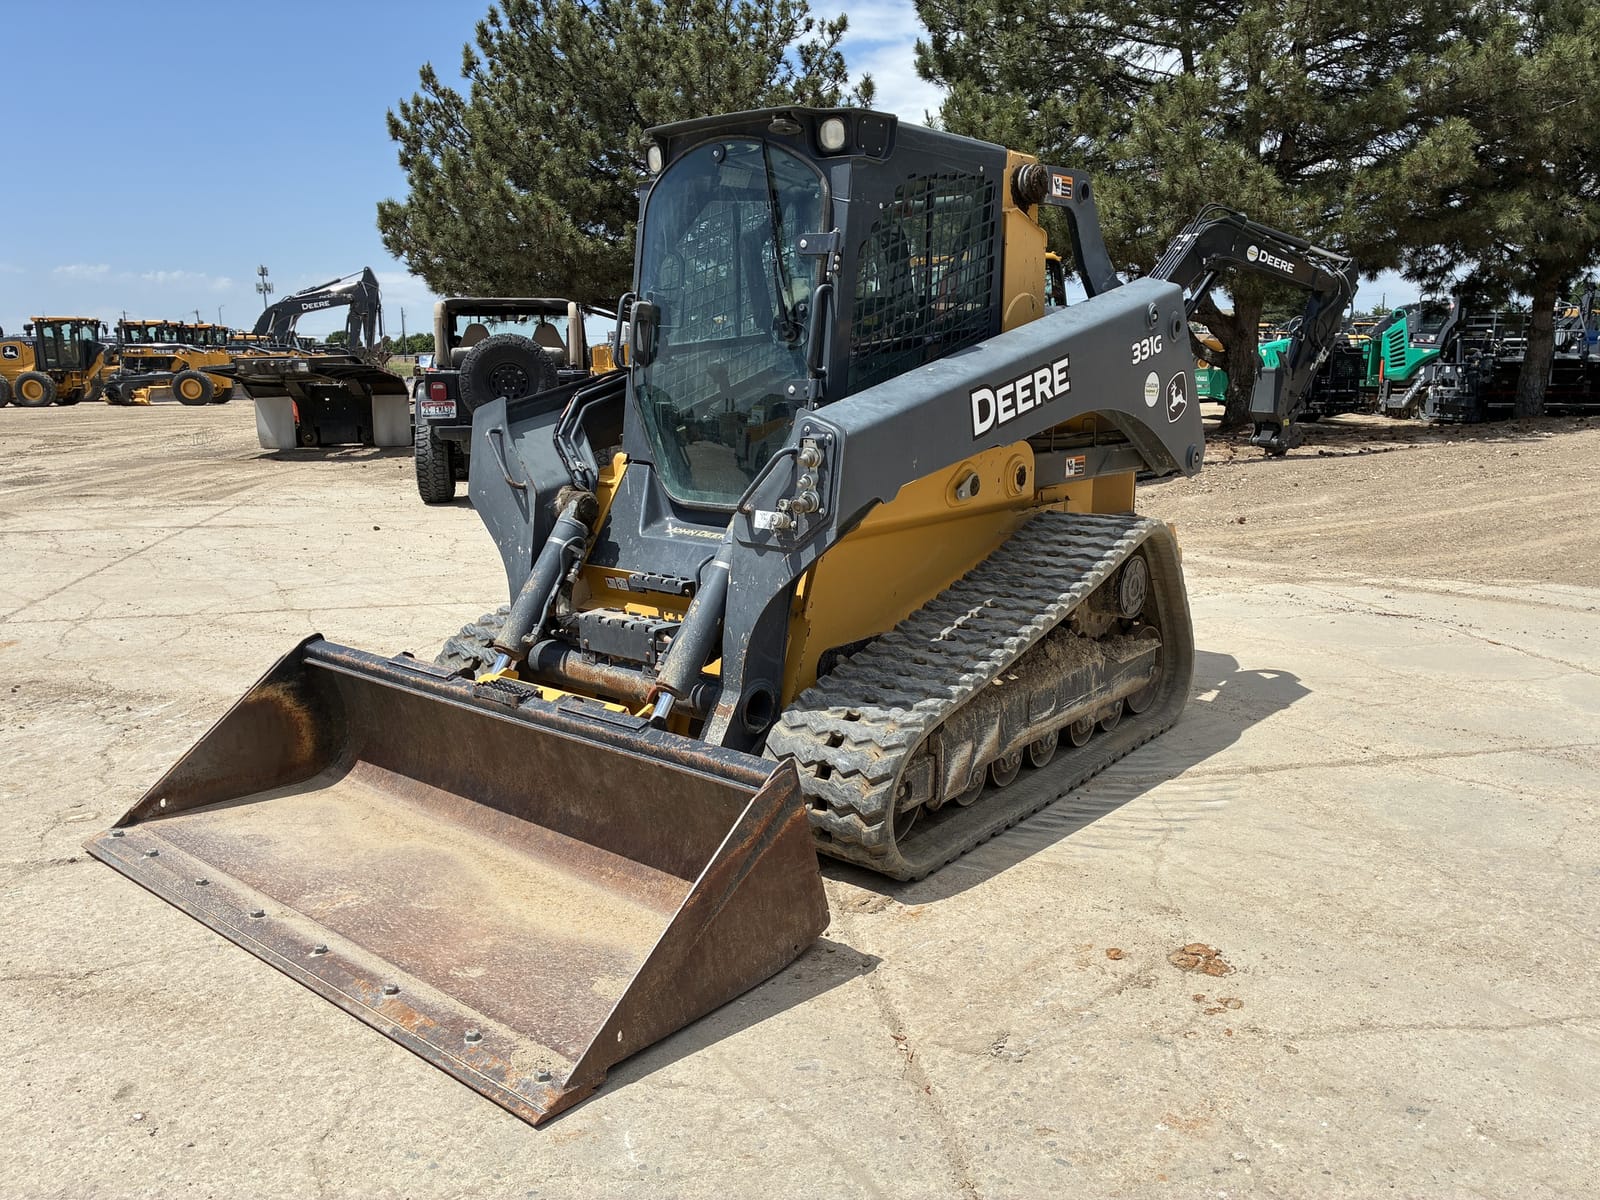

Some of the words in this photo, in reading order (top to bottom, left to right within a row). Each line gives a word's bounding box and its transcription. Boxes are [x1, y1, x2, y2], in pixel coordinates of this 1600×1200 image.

[1259, 249, 1295, 274] DEERE
[301, 300, 331, 310] DEERE
[1132, 334, 1162, 365] 331G
[971, 357, 1070, 437] DEERE
[696, 529, 726, 540] DEER
